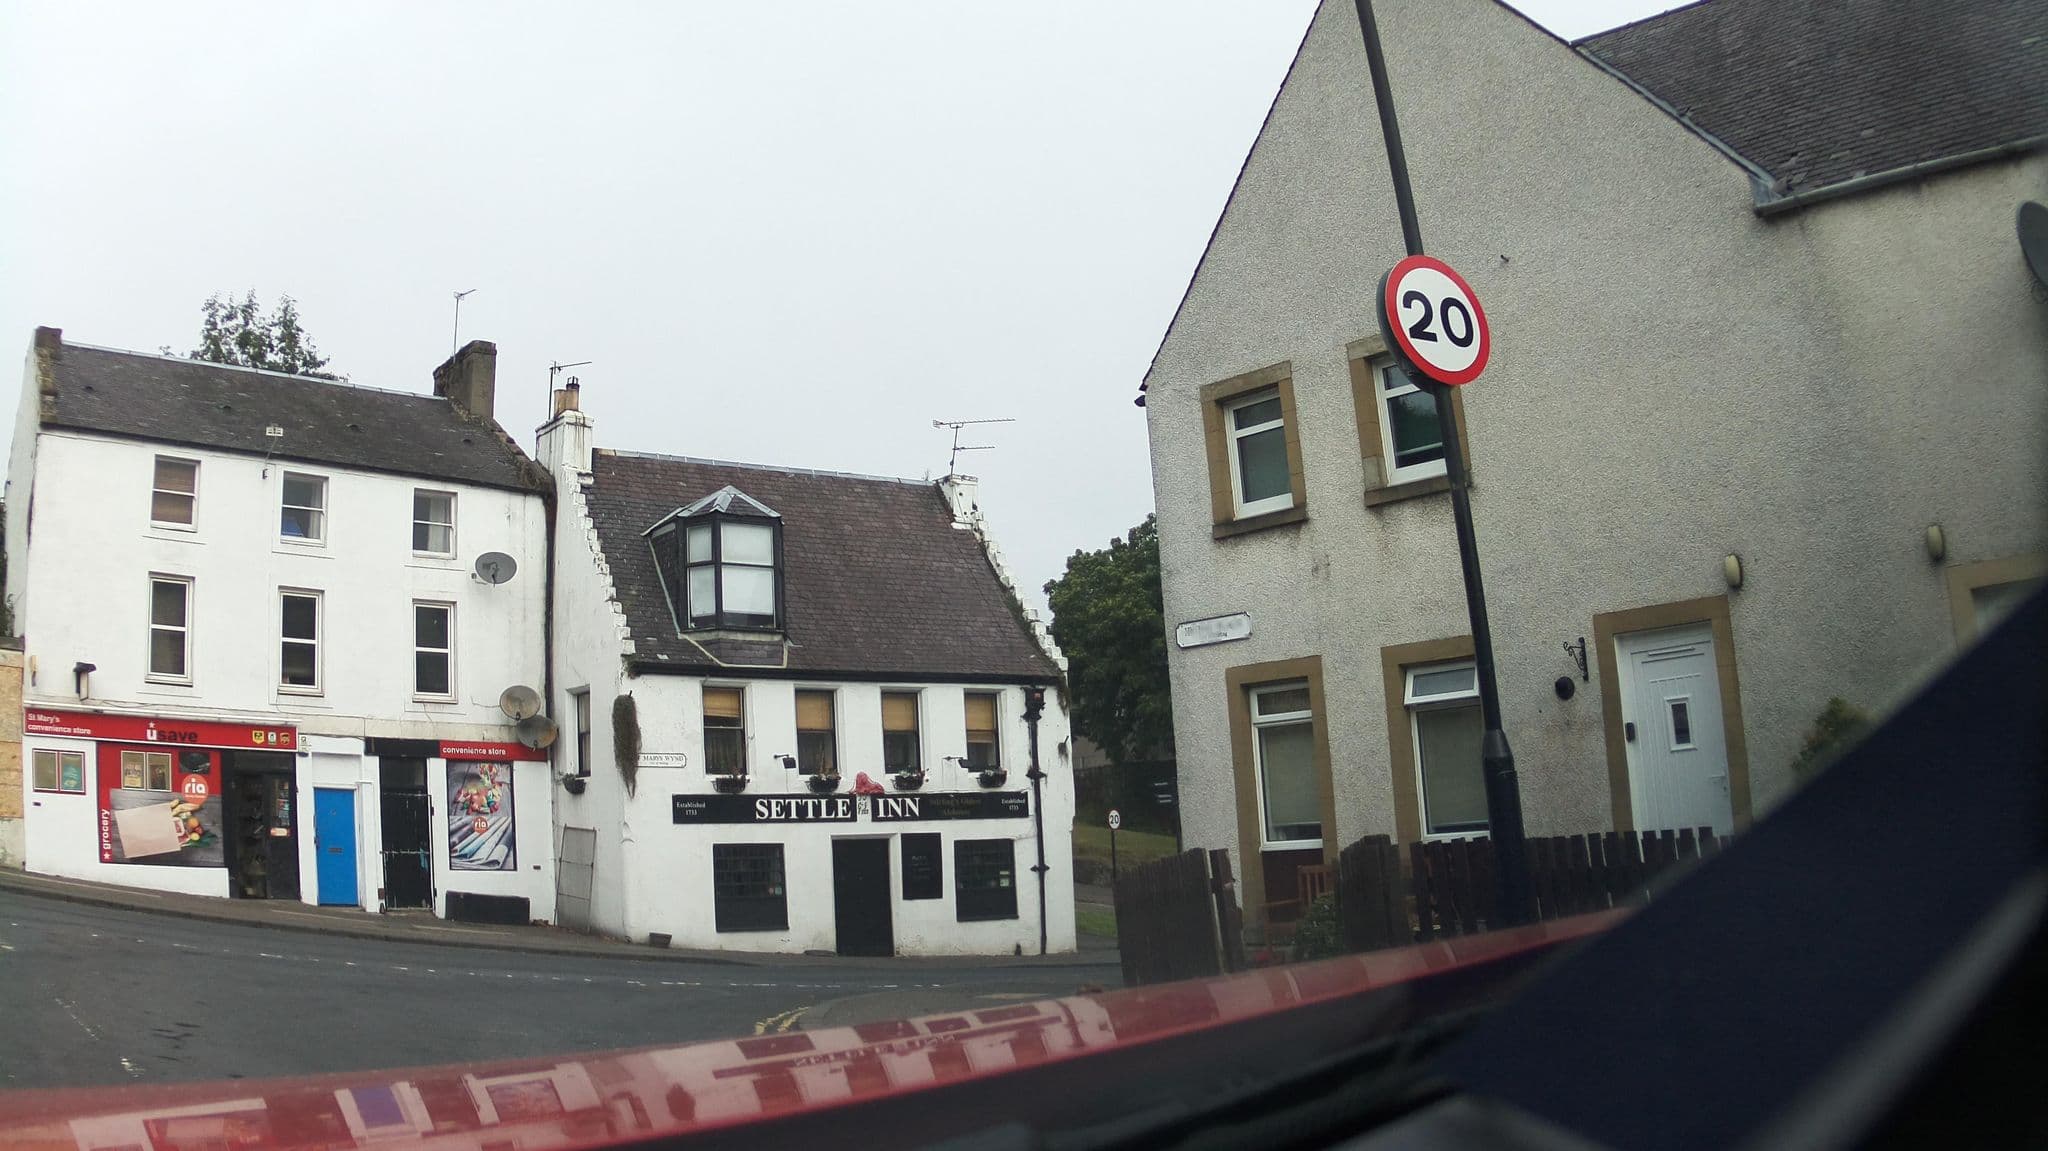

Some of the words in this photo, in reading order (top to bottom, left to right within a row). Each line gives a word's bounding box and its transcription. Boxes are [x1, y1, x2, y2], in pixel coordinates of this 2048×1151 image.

[1402, 290, 1474, 348] 20
[28, 713, 36, 721] St
[27, 723, 72, 734] convenience
[72, 726, 92, 735] store
[442, 746, 487, 756] convenience
[488, 748, 506, 756] store
[184, 777, 206, 794] ria
[755, 798, 852, 820] SETTLE
[876, 797, 921, 818] INN
[474, 819, 487, 829] ria
[1109, 814, 1120, 825] 20
[102, 808, 111, 850] grocery
